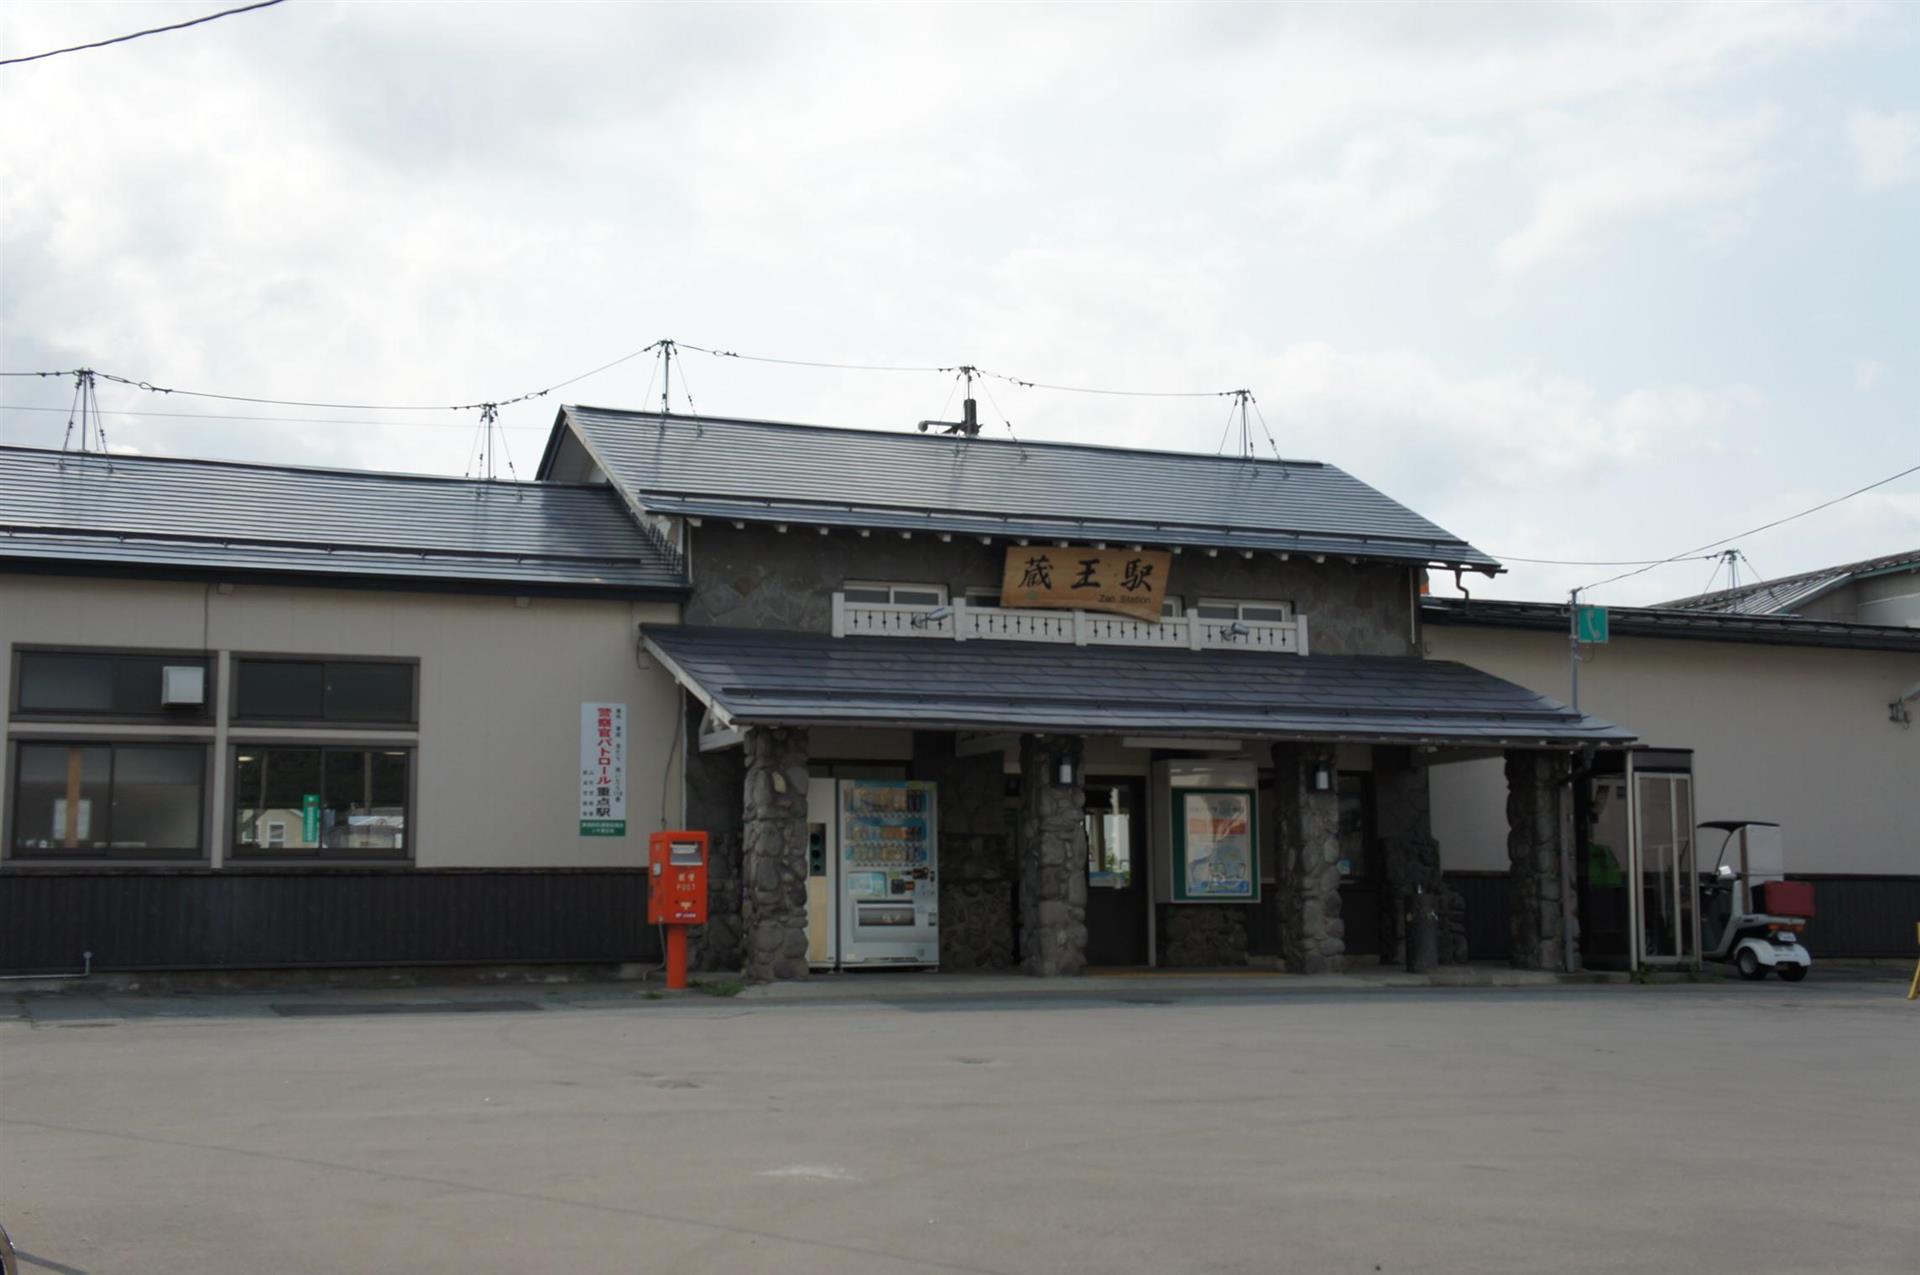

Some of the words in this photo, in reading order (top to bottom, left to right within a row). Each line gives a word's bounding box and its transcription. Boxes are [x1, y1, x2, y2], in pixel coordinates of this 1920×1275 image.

[1018, 554, 1154, 592] 蔵王駅
[1098, 594, 1116, 603] Zao
[1120, 594, 1152, 604] Station
